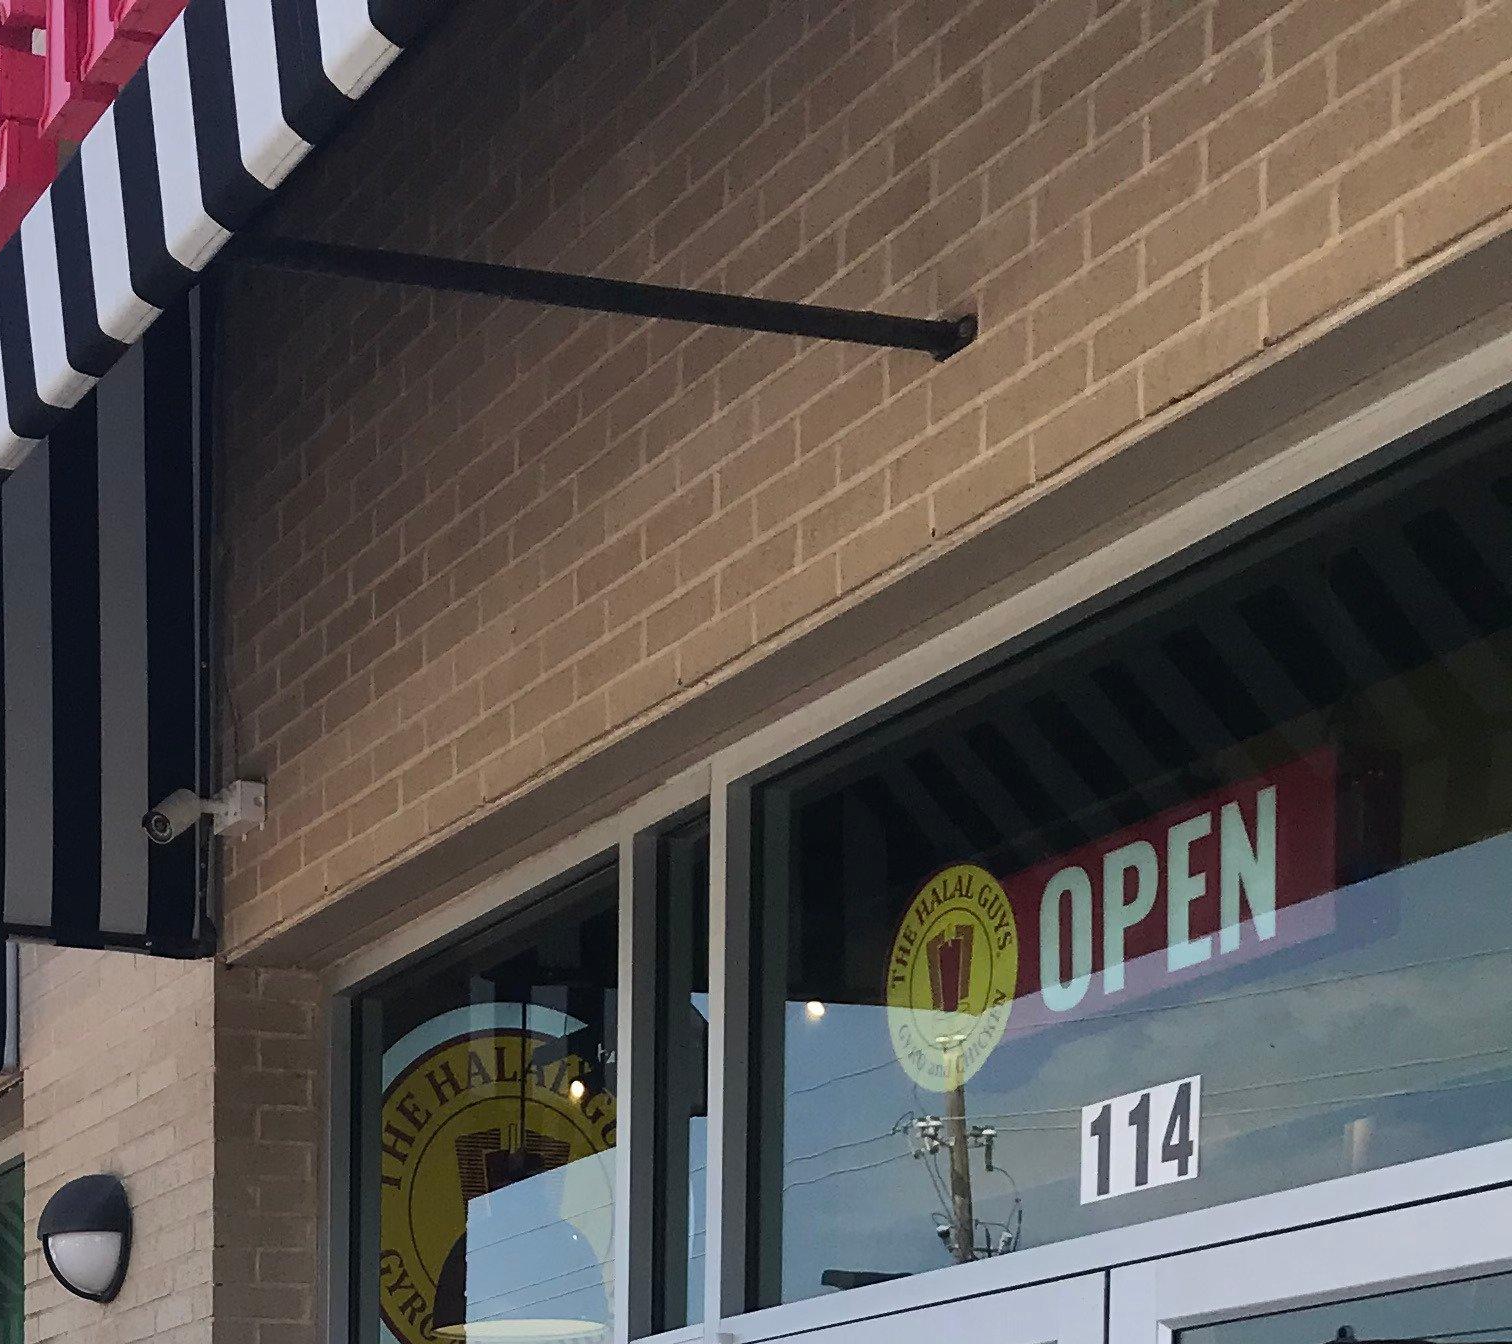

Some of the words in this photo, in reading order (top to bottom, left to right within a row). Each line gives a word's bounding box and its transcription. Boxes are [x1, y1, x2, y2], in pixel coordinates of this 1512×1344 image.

[892, 925, 918, 990] THE
[915, 873, 975, 925] HALAL
[1039, 786, 1277, 1012] OPEN
[1089, 1081, 1195, 1198] 114
